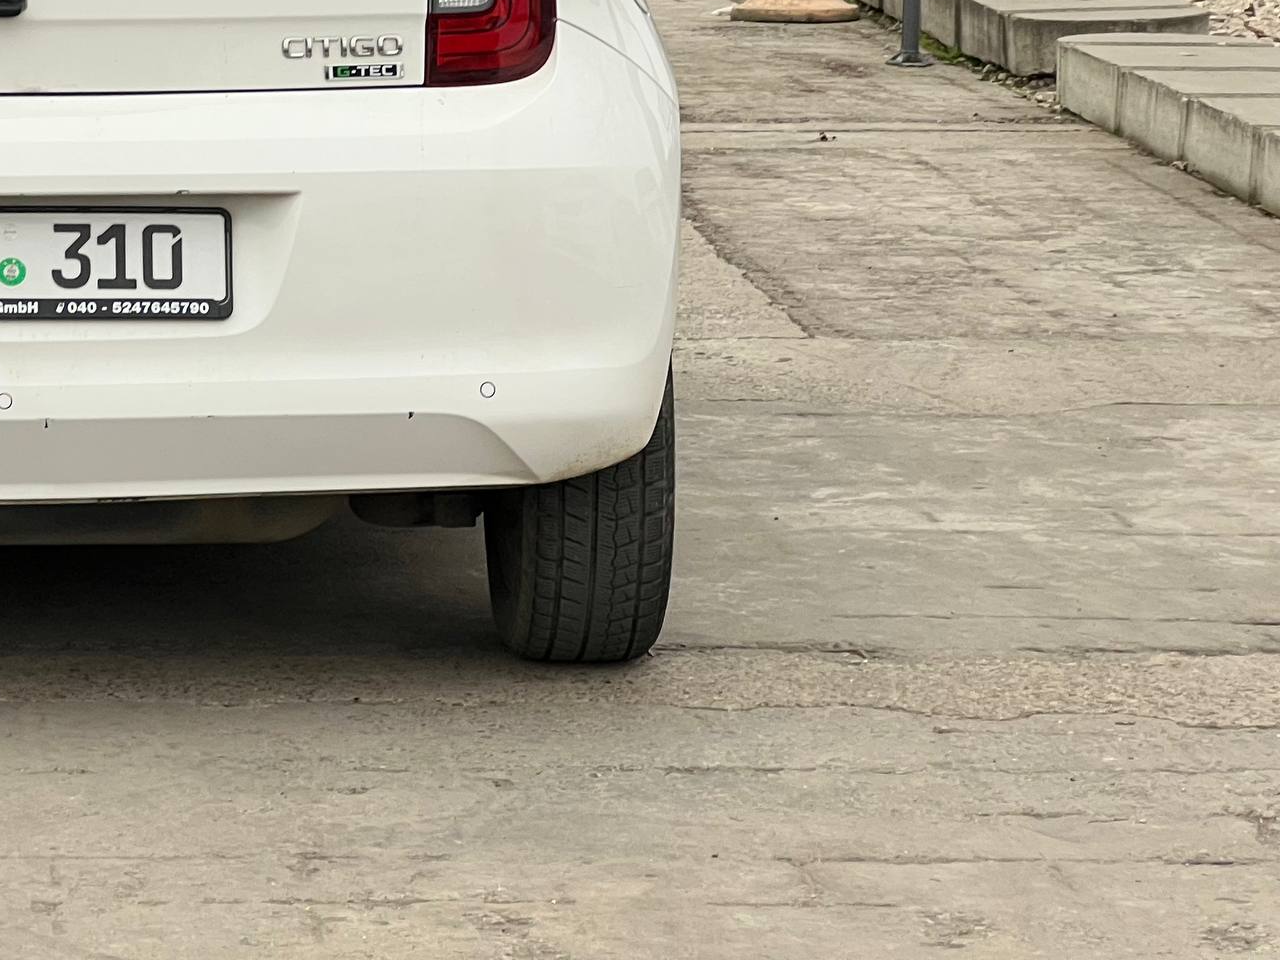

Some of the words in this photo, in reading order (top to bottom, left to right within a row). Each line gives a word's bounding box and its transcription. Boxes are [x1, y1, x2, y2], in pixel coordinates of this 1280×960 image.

[282, 35, 404, 59] CITIGO
[51, 223, 183, 291] 310
[67, 301, 97, 314] 040
[112, 301, 210, 315] 5247645790
